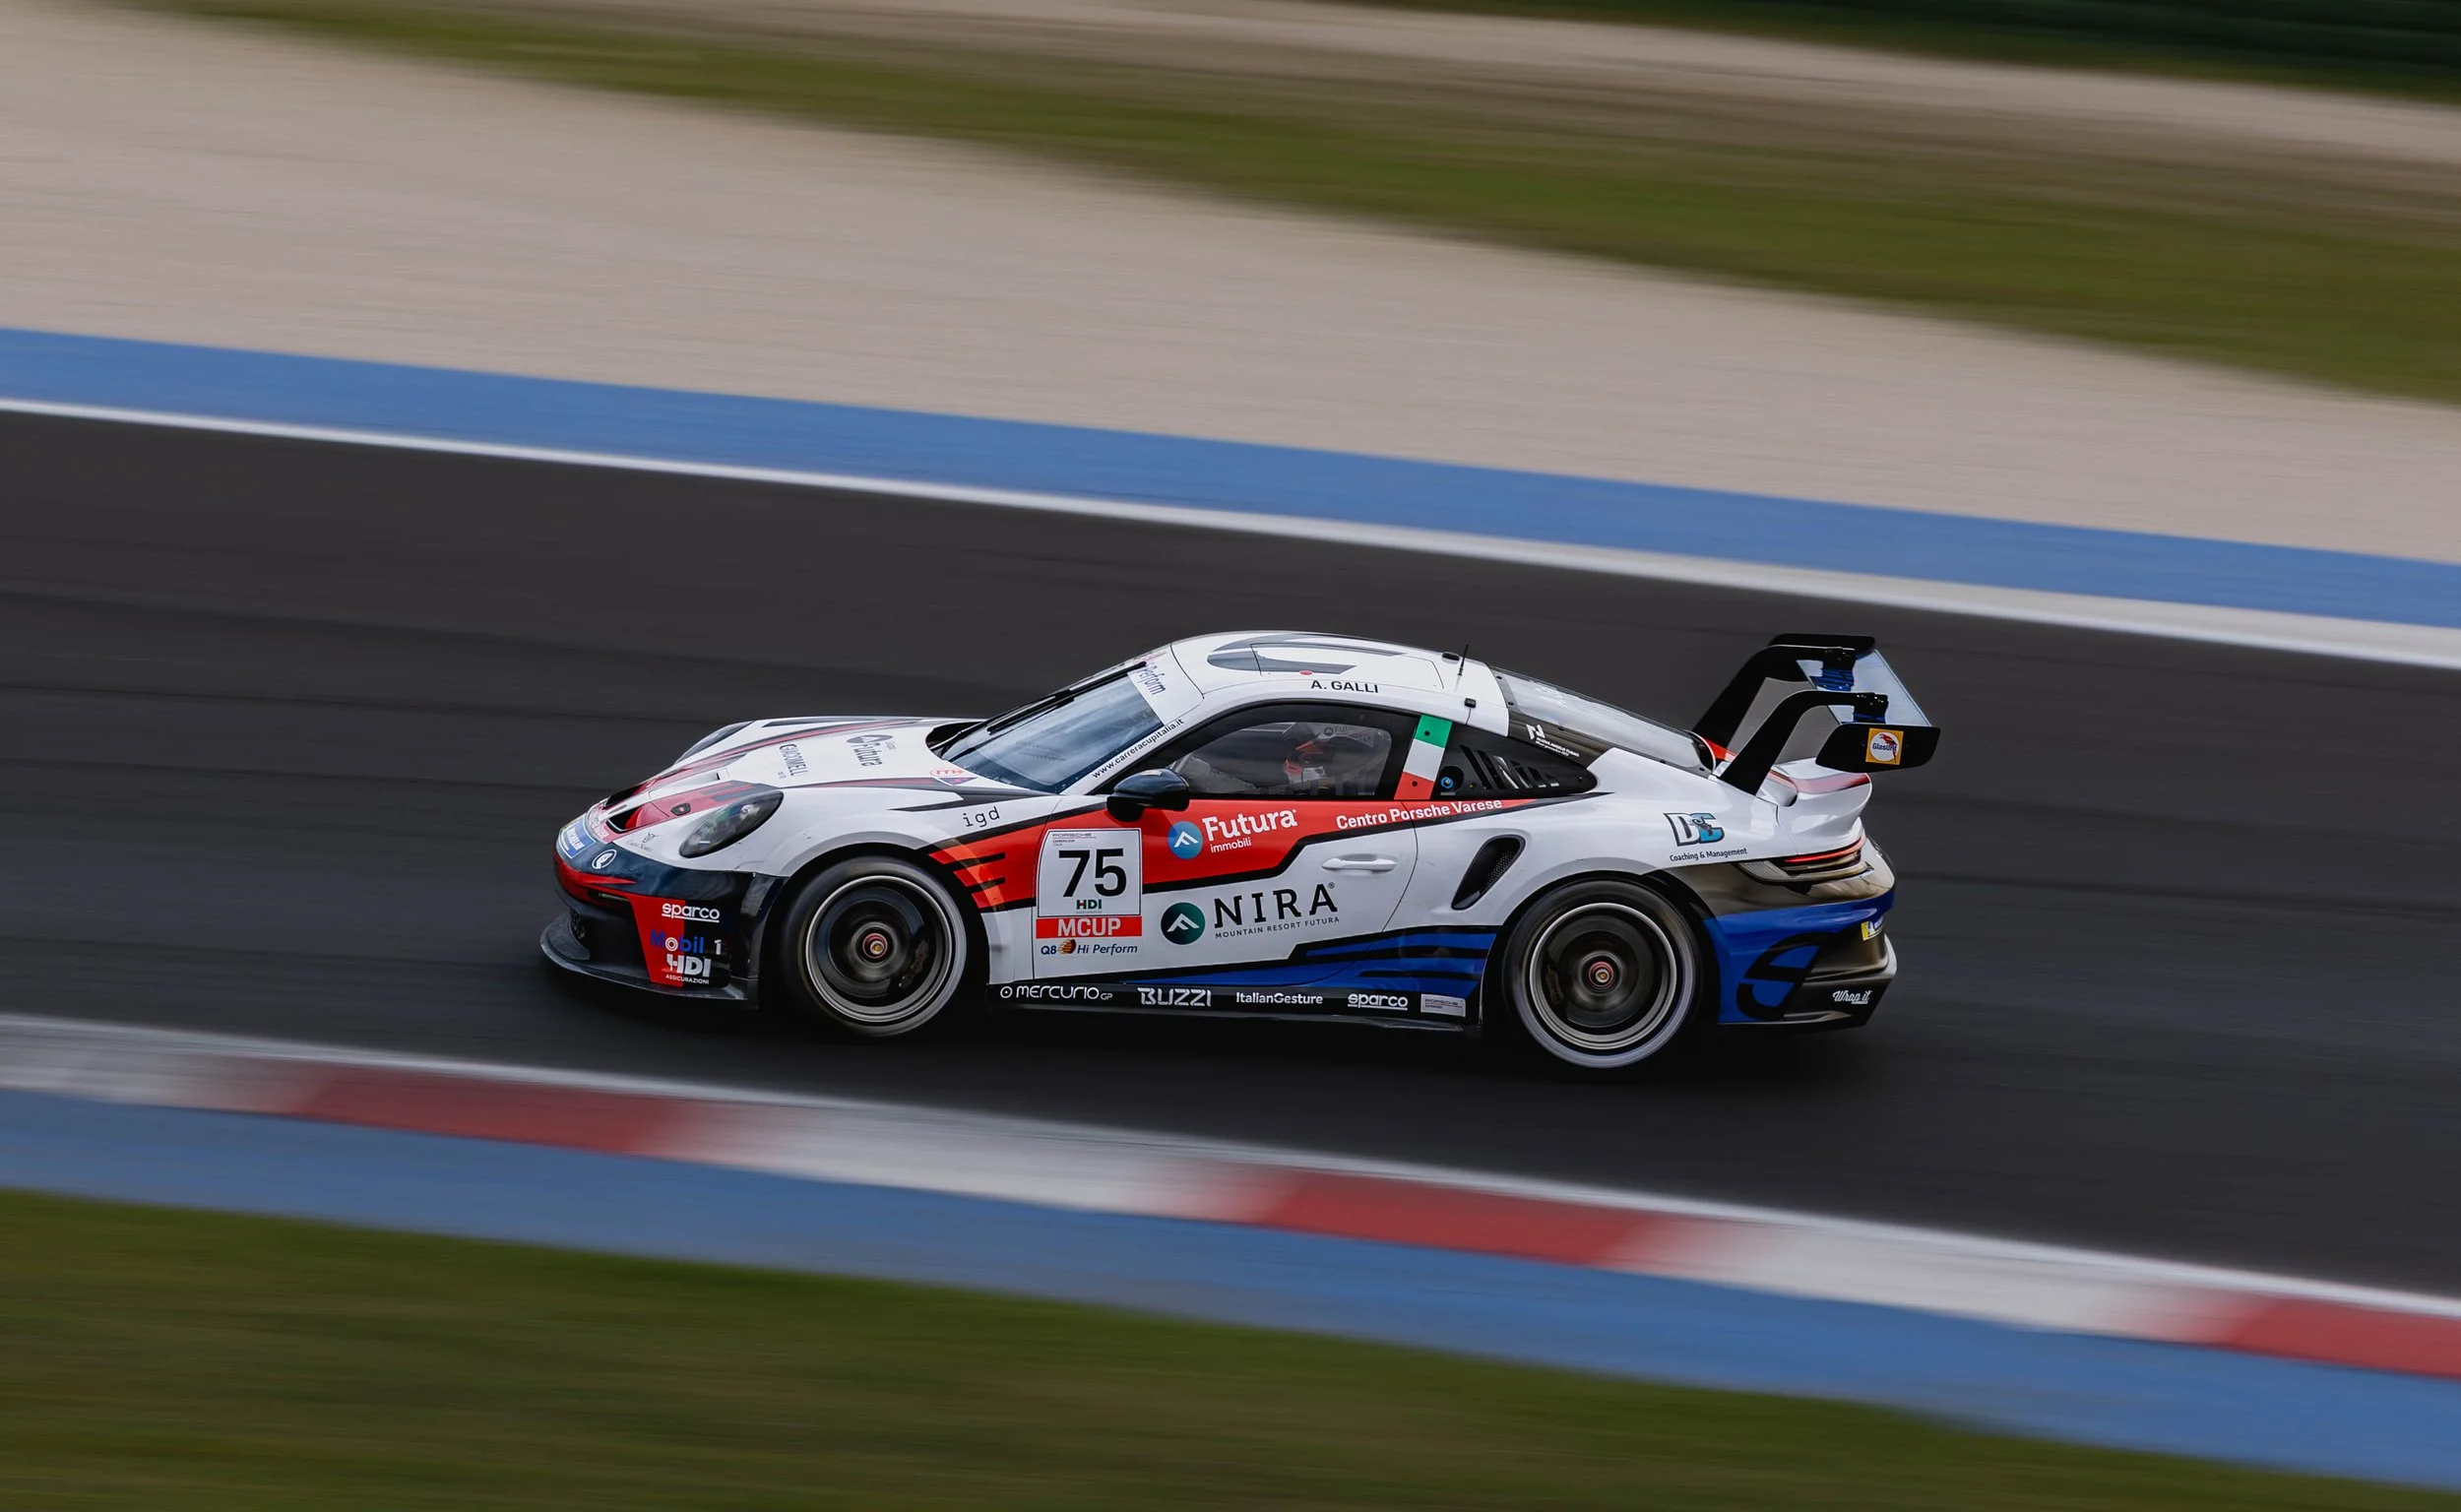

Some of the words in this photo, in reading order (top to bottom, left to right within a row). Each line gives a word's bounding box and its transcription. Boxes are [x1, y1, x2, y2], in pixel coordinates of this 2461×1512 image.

[1310, 679, 1327, 690] A.
[1331, 680, 1379, 693] GALLI
[1092, 719, 1184, 779] www.carreracupitalia.it
[963, 805, 1000, 828] igd
[1336, 813, 1387, 830] Centro
[1389, 804, 1450, 822] Porsche
[1451, 799, 1502, 814] Varese
[1202, 810, 1297, 842] Futura
[1210, 837, 1252, 853] immobili
[1670, 852, 1699, 862] Coaching
[1699, 850, 1705, 859] &
[1706, 848, 1748, 858] Management
[1058, 848, 1127, 898] 75
[662, 903, 721, 921] sparco
[1076, 899, 1103, 911] HDI
[1214, 883, 1338, 928] NIRA
[1057, 917, 1121, 937] MCUP
[1215, 927, 1263, 939] MOUNTAIN
[1267, 921, 1301, 932] RESORT
[1304, 916, 1340, 927] FUTURA
[651, 928, 705, 954] Mobil
[714, 938, 723, 956] 1
[1041, 945, 1057, 956] Q8
[1077, 944, 1090, 954] Hi
[1093, 943, 1138, 956] Perform
[666, 953, 712, 977] HDI
[665, 974, 710, 984] ASSICURAZIONI
[1235, 991, 1323, 1004] ItalianGesture
[1348, 992, 1409, 1009] sparco
[1832, 989, 1862, 1003] Wrap
[1862, 989, 1873, 1002] it
